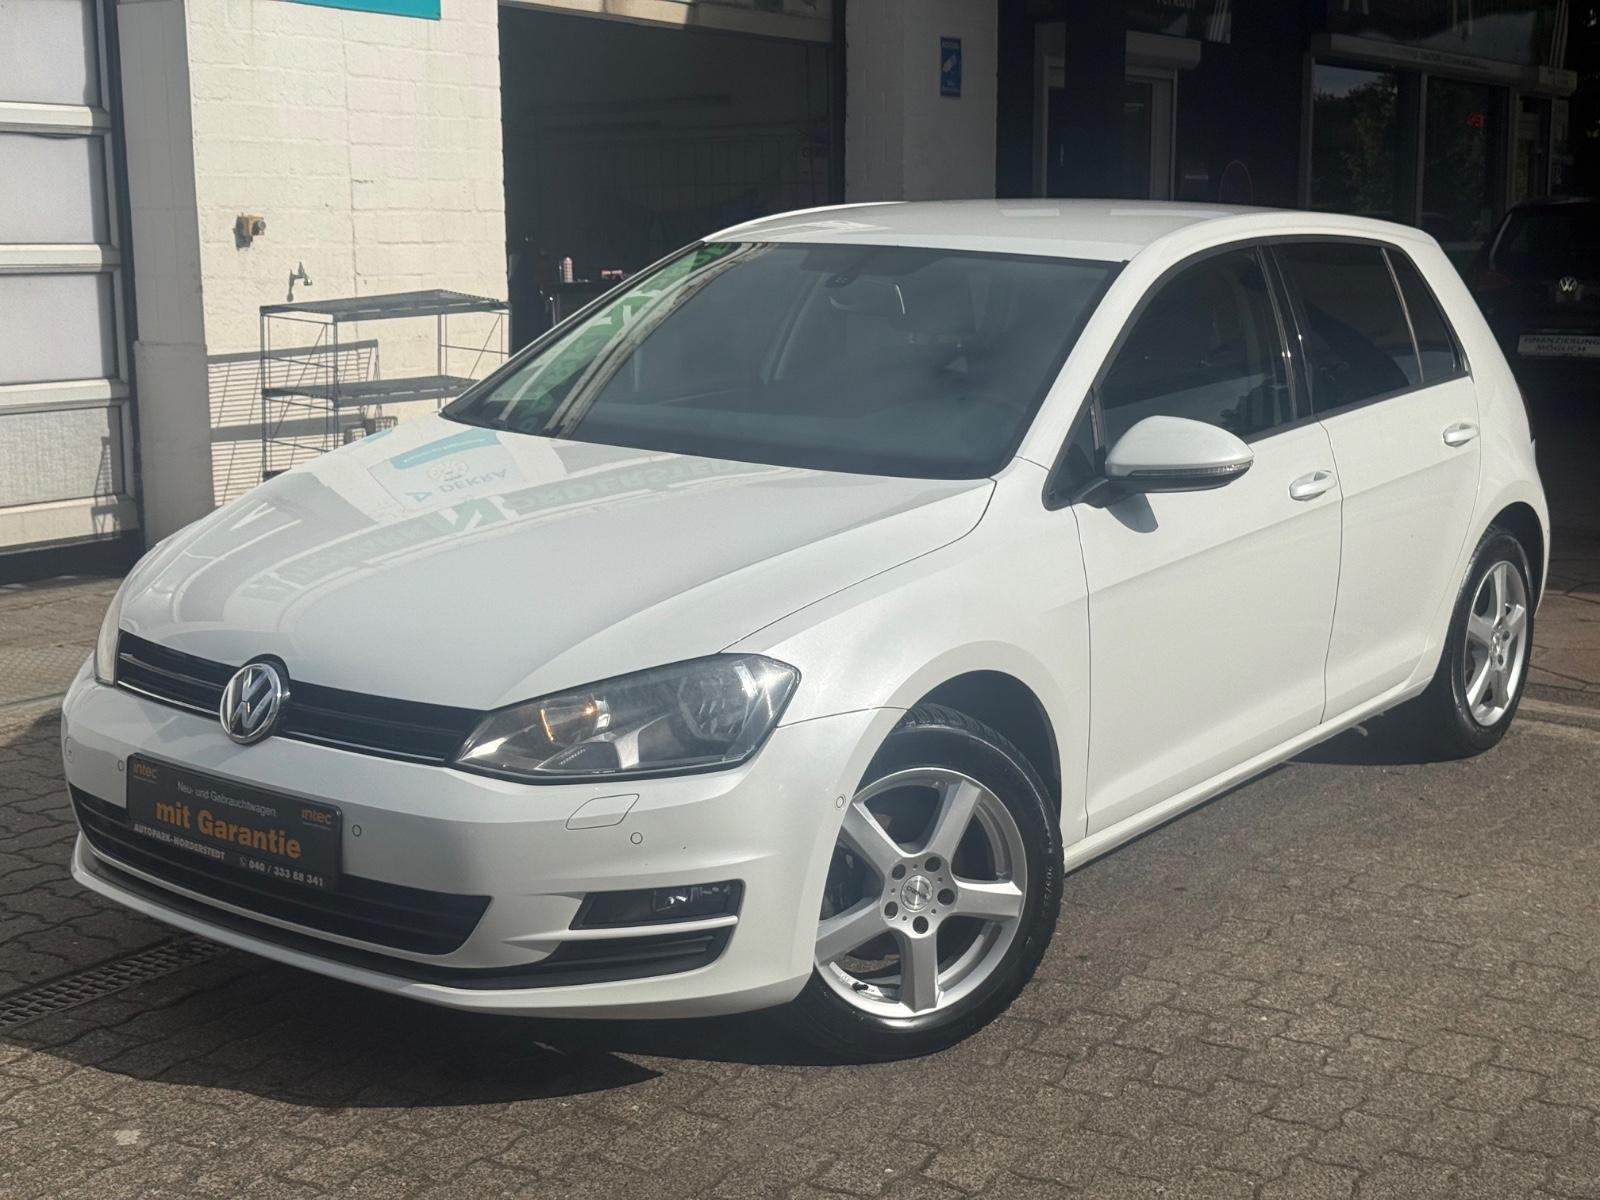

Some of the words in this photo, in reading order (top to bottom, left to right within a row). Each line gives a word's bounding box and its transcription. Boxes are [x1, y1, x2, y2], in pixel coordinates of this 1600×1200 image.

[222, 664, 280, 742] VW
[156, 801, 191, 829] mit
[197, 809, 301, 859] Garantie
[303, 808, 332, 825] intec
[249, 859, 265, 872] 040
[273, 866, 290, 879] 333
[306, 874, 323, 887] 341
